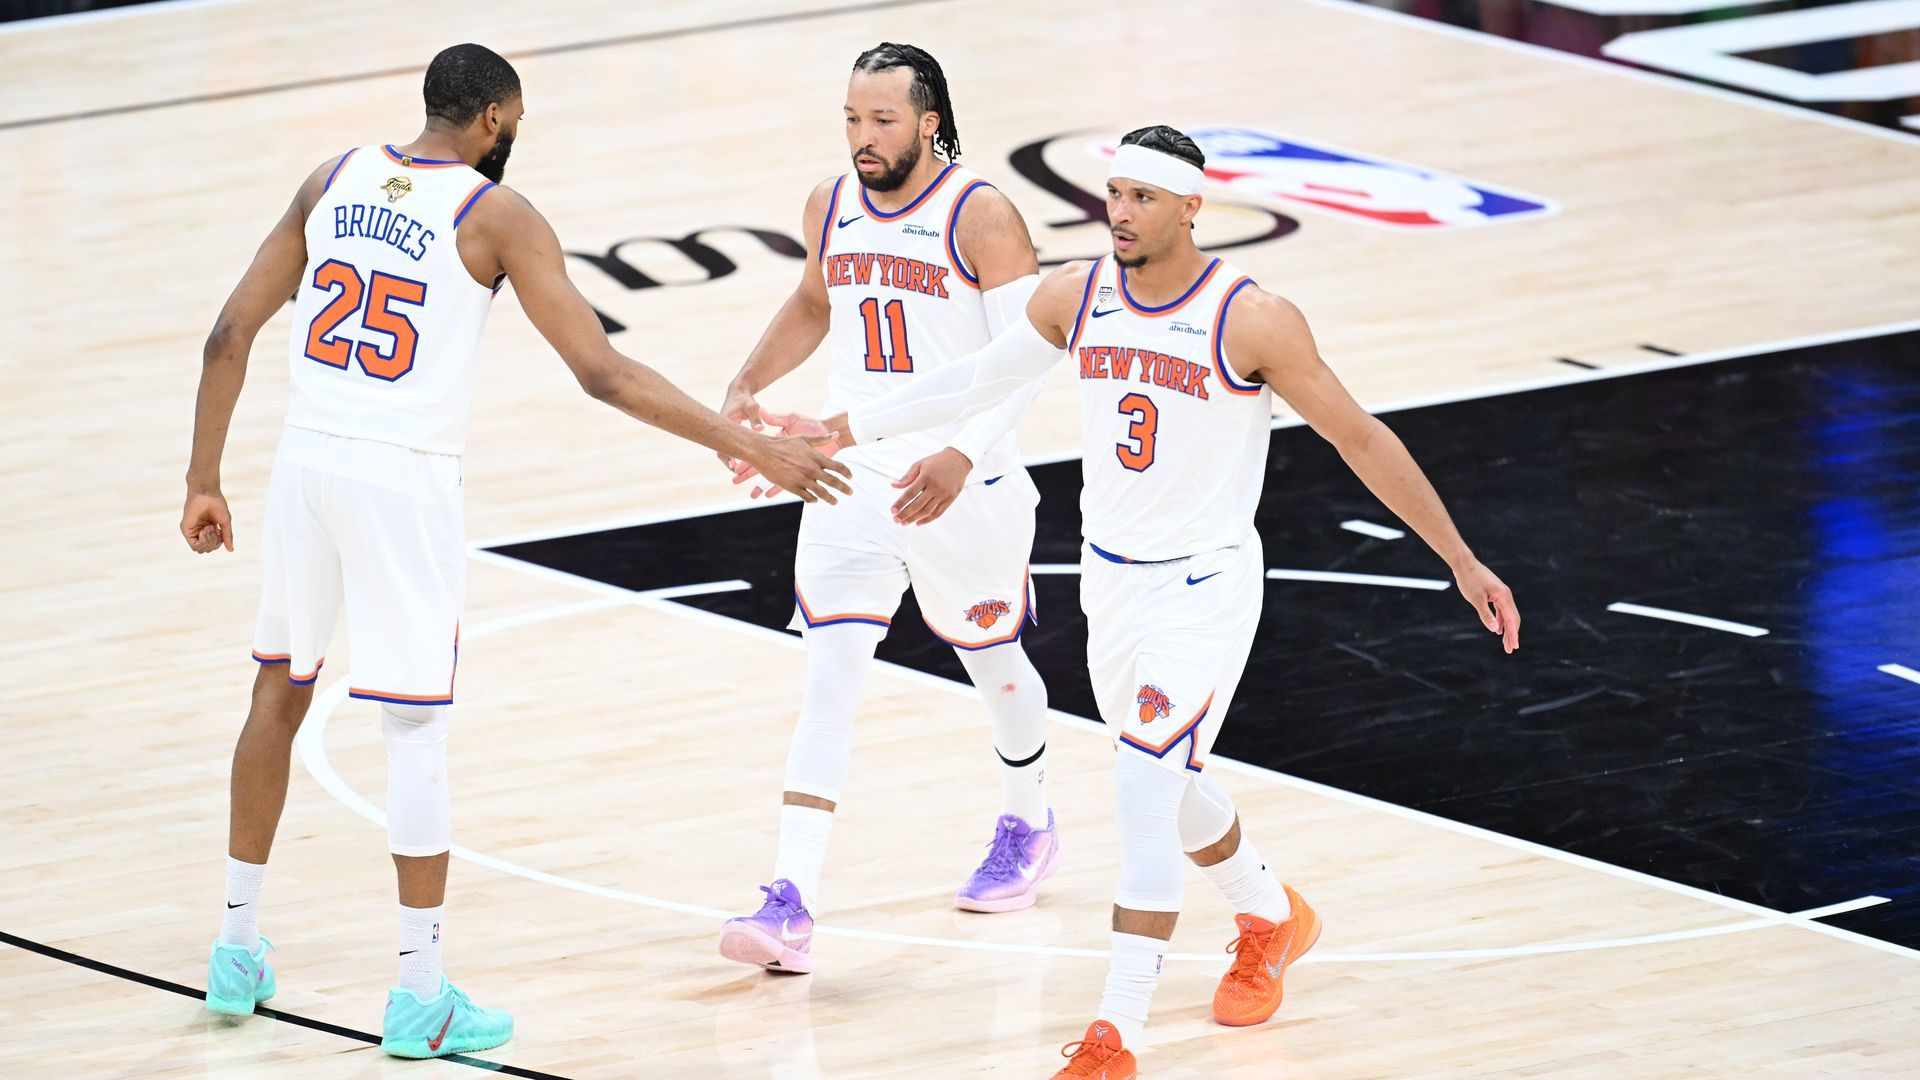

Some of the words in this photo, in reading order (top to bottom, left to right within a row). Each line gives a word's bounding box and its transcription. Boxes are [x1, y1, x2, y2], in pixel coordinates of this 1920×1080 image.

[334, 204, 435, 261] BRIDGES
[827, 253, 876, 288] NEW
[877, 253, 949, 299] YORK
[304, 258, 427, 382] 25
[859, 297, 914, 373] 11
[1079, 347, 1135, 380] NEW
[1137, 349, 1211, 401] YORK
[1116, 392, 1159, 473] 3
[965, 600, 1011, 622] KNICKS
[1137, 684, 1170, 719] KNICKS
